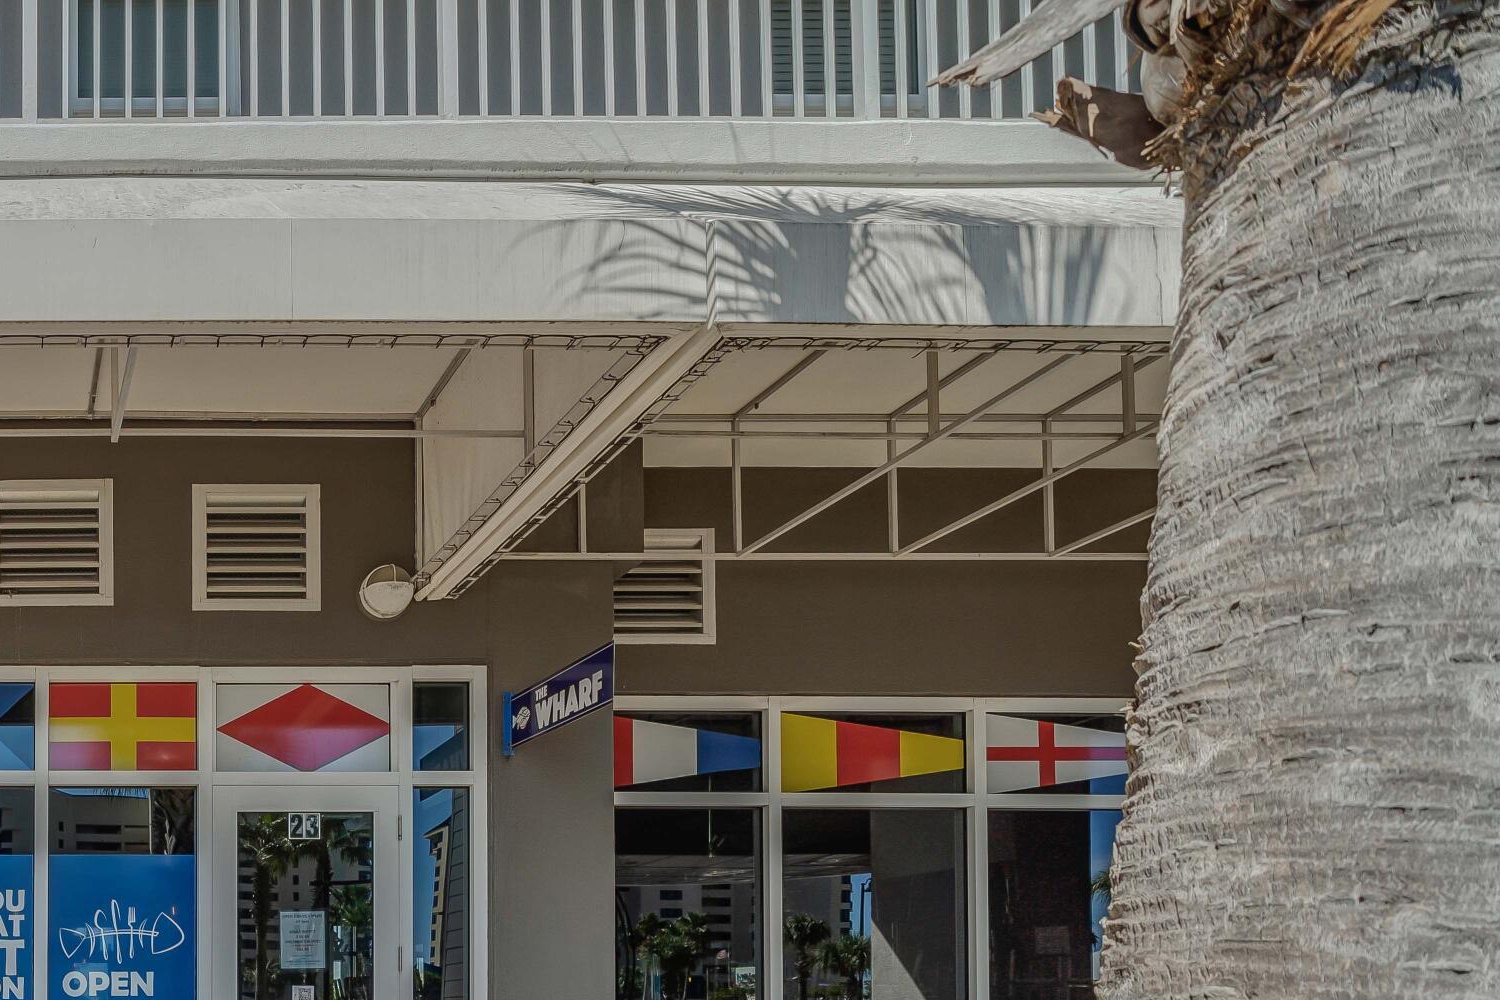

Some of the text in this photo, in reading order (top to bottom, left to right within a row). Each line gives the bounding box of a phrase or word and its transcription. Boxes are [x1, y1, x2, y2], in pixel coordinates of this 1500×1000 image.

[535, 685, 548, 701] THE
[535, 670, 603, 730] WHARF
[290, 814, 319, 837] 23
[62, 971, 155, 997] OPEN
